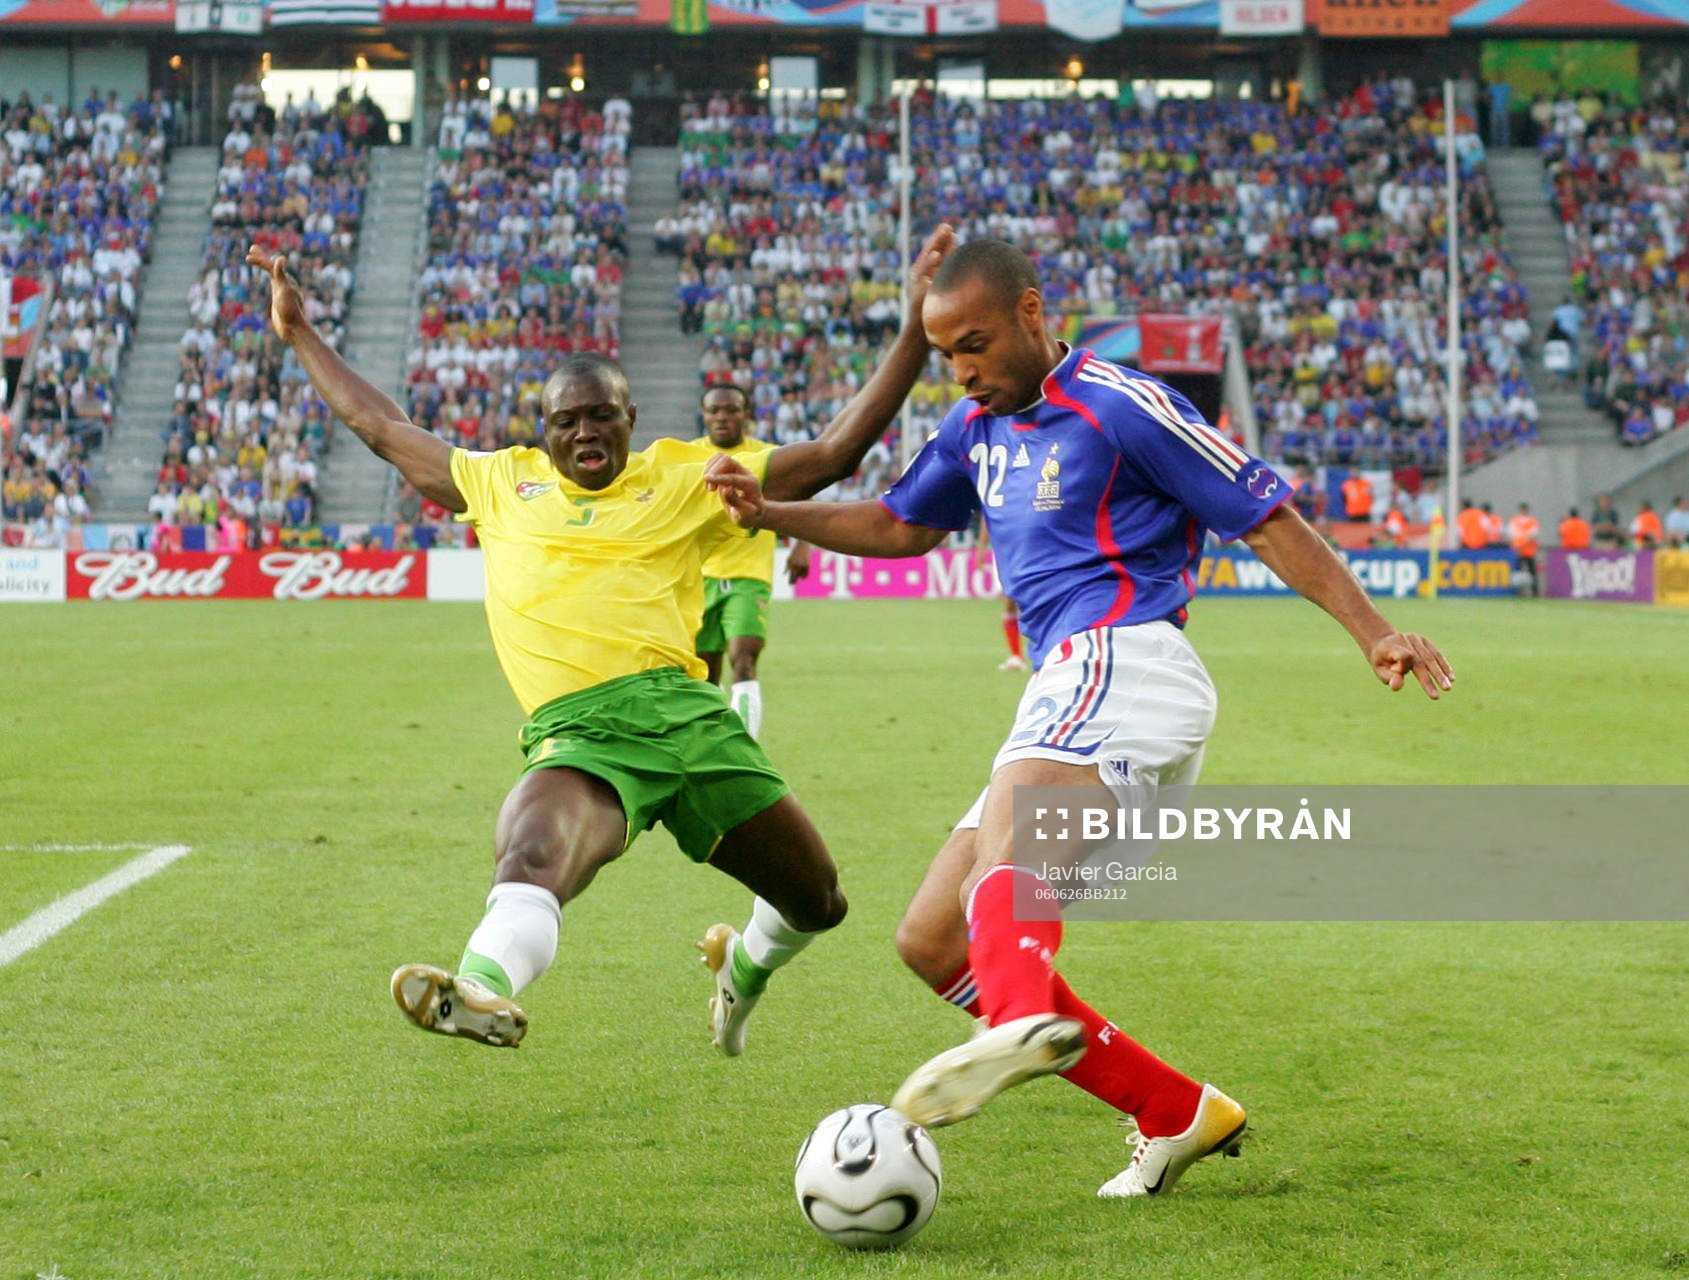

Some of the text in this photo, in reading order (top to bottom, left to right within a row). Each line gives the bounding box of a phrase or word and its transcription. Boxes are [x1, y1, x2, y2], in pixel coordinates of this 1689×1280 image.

[968, 442, 1008, 507] 12
[74, 552, 232, 599] Bud
[258, 552, 416, 599] Bud
